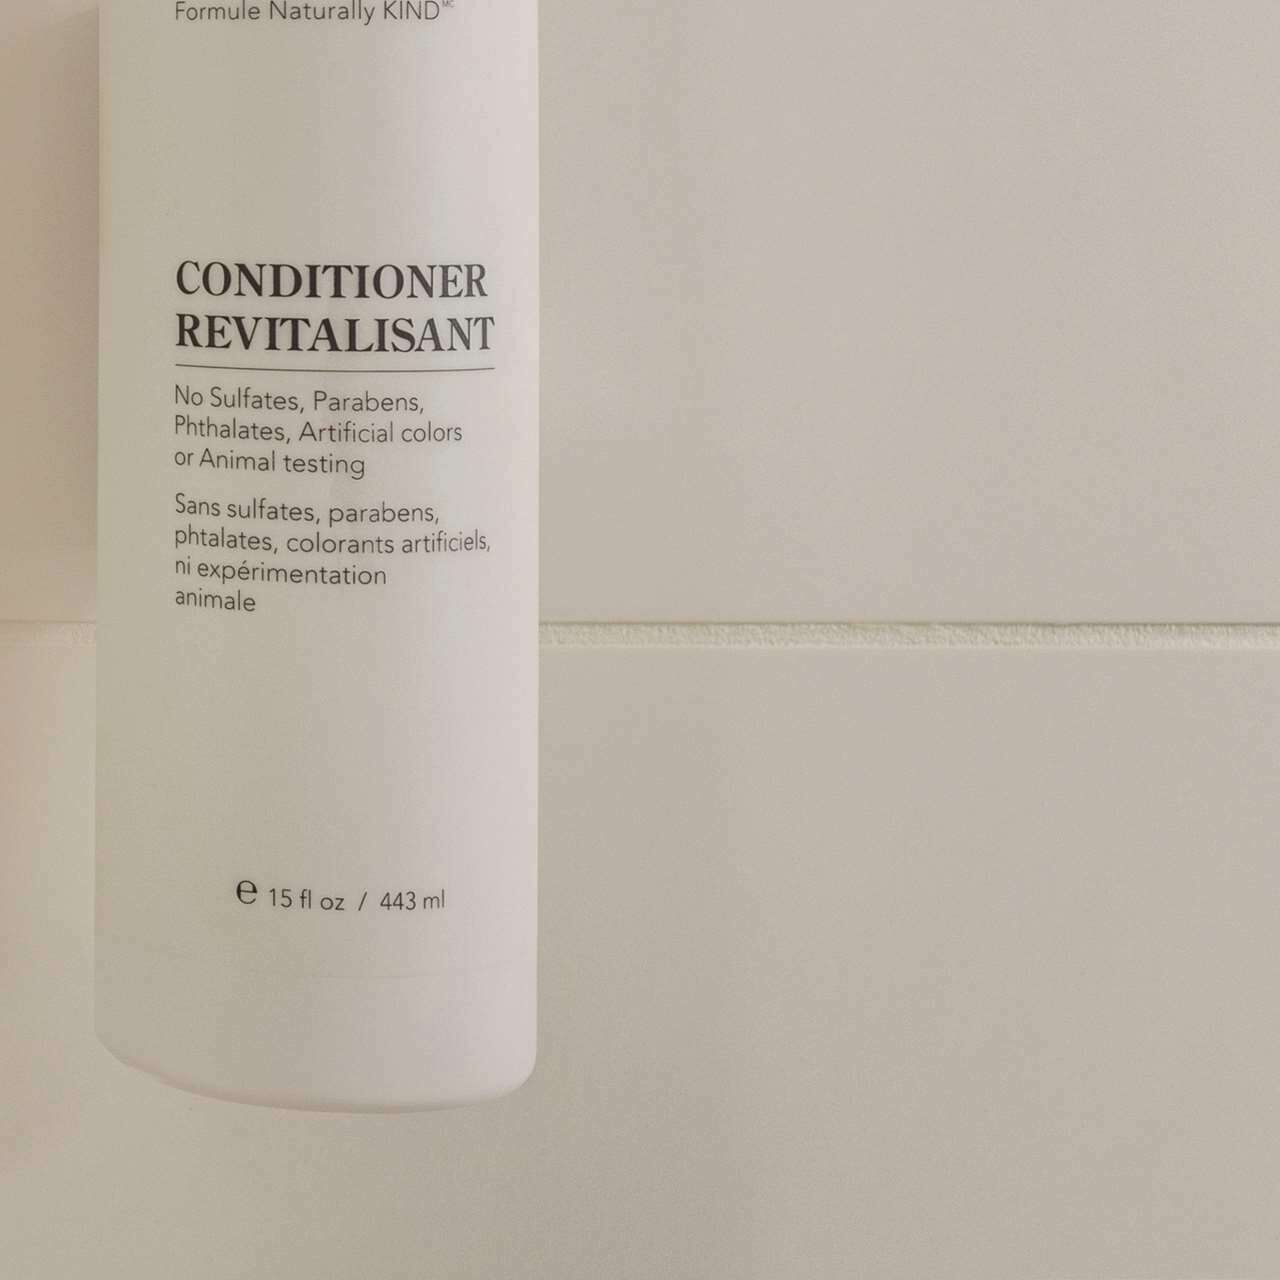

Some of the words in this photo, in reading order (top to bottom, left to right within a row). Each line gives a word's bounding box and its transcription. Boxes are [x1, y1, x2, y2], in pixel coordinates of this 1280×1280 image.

[176, 0, 261, 21] Formule
[176, 260, 488, 299] CONDITIONER
[175, 312, 495, 353] REVITALISANT
[175, 384, 203, 406] No
[210, 386, 304, 414] Sulfates,
[314, 390, 424, 415] Parabens,
[175, 414, 291, 445] Phthalates,
[298, 420, 394, 443] Artificial
[401, 420, 462, 443] colors
[174, 451, 194, 466] or
[199, 448, 275, 472] Animal
[282, 453, 365, 480] testing
[175, 492, 221, 517] Sans
[226, 497, 320, 525] sulfates,
[328, 501, 439, 528] parabens,
[175, 523, 278, 555] phtalates,
[286, 532, 394, 554] colorants
[402, 528, 490, 554] artificiels,
[176, 557, 190, 575] ni
[197, 560, 386, 585] expérimentation
[175, 588, 256, 612] animale
[269, 888, 293, 910] 15
[299, 888, 312, 910] fl
[320, 897, 346, 911] oz
[358, 891, 367, 911] /
[380, 891, 416, 912] 443
[423, 888, 445, 910] ml
